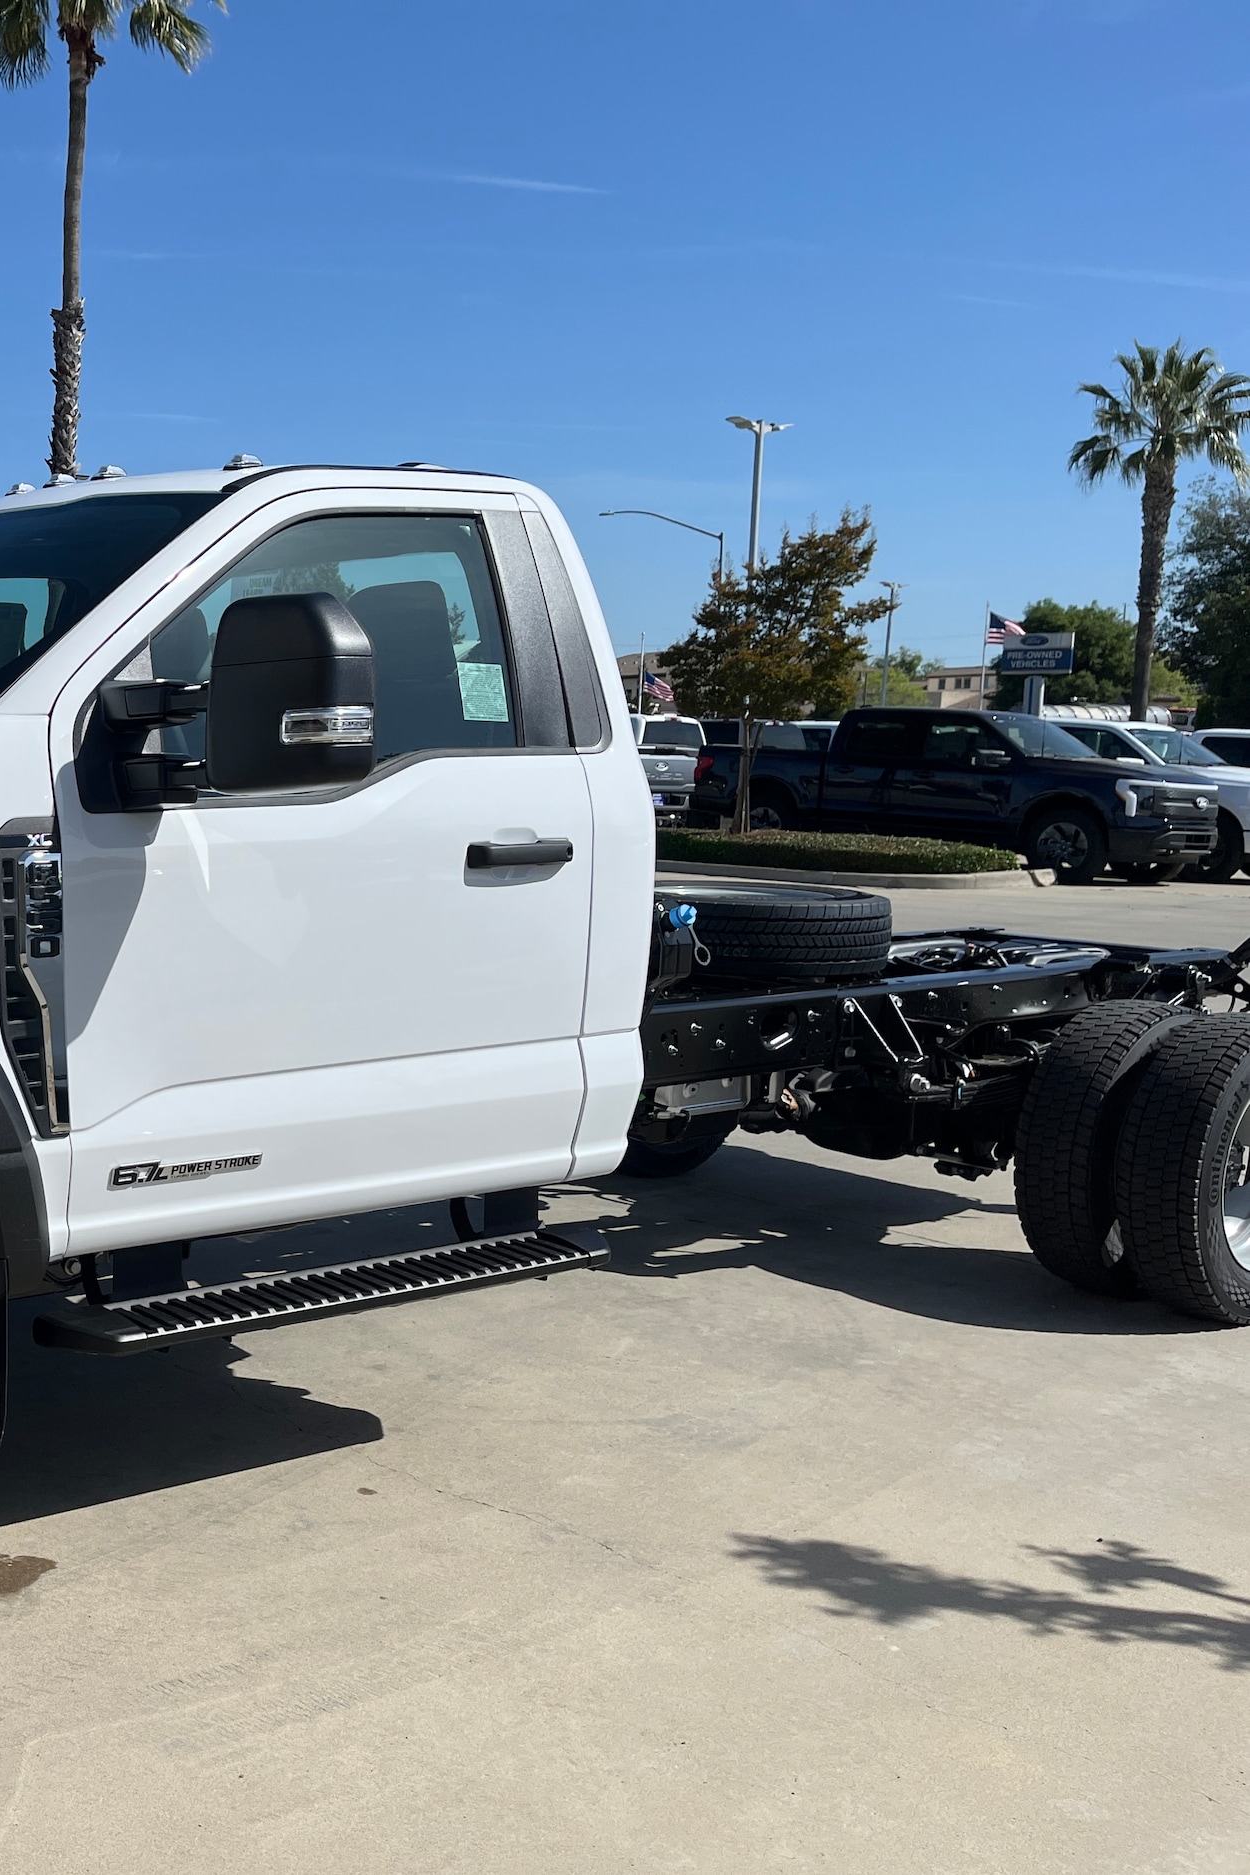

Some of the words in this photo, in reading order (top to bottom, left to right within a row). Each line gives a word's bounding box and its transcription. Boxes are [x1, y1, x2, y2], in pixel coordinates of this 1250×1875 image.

[1006, 650, 1063, 660] PRE-OWNED
[1010, 660, 1056, 668] VEHICLES
[26, 834, 53, 847] XL
[1209, 1090, 1244, 1208] Continental
[112, 1162, 168, 1186] 6.7L
[170, 1161, 212, 1175] POWER
[214, 1155, 261, 1170] STROKE
